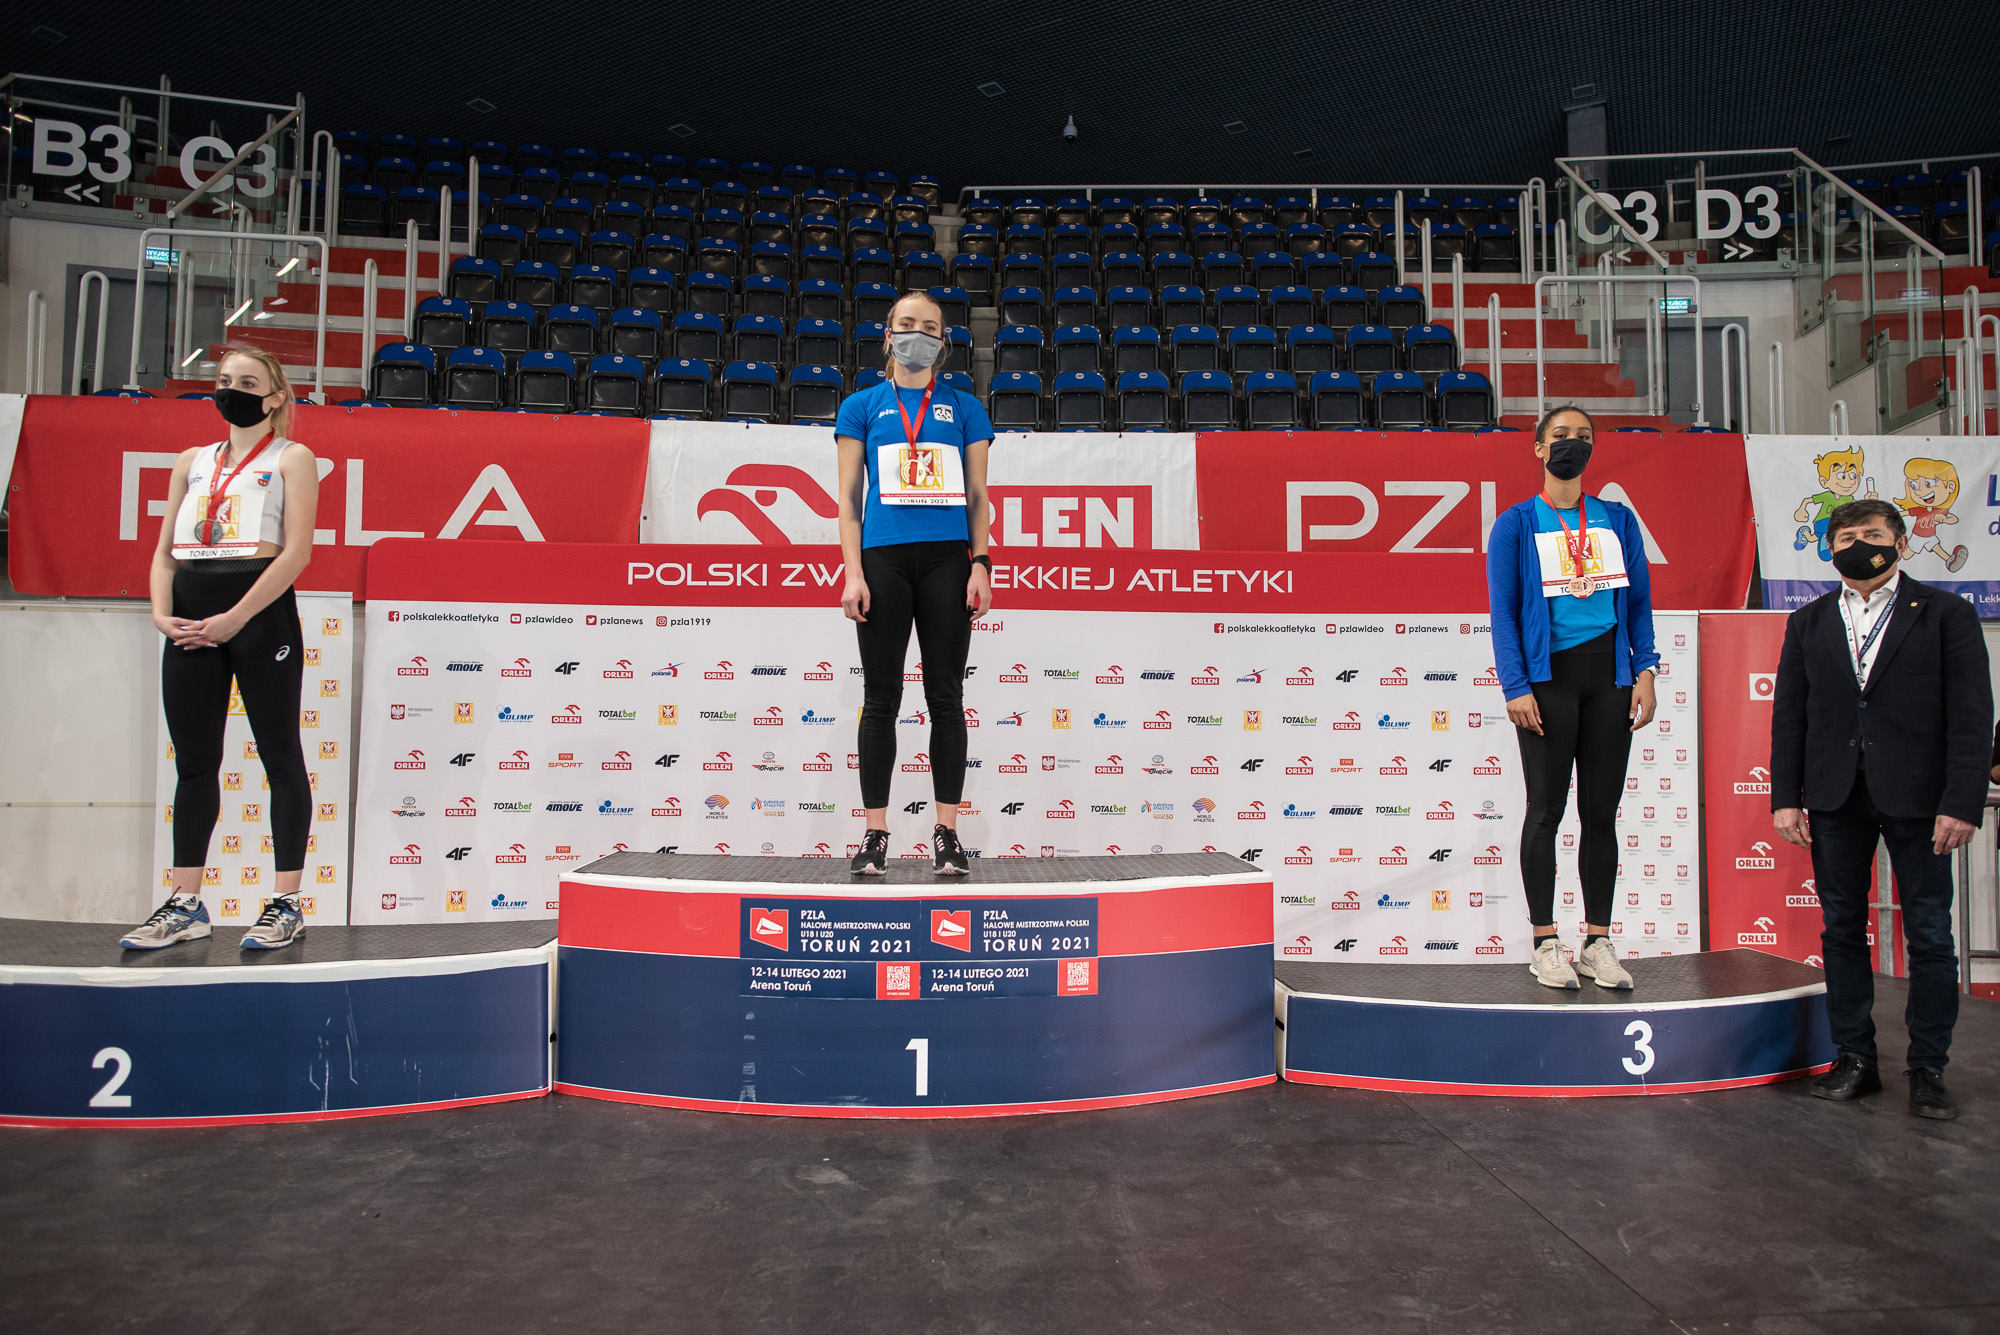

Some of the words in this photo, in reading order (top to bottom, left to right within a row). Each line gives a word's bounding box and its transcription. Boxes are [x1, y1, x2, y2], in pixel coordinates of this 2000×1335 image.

[33, 118, 132, 183] B3
[179, 136, 278, 198] C3
[1575, 190, 1660, 245] C3
[1696, 185, 1781, 240] D3
[1920, 516, 1936, 529] OLA
[628, 562, 768, 587] POLSKI
[990, 565, 1115, 591] EKKIEJ
[1126, 568, 1294, 595] ATLETYKI
[403, 613, 499, 622] polskalekkoatletyka
[525, 616, 573, 625] pzlawideo
[600, 617, 643, 626] pzlanews
[671, 618, 711, 627] pzla1919
[1228, 625, 1315, 634] polskalekkoatletyka
[1340, 625, 1384, 633] pzlawideo
[1409, 625, 1448, 634] pzlanews
[555, 662, 580, 675] 4F
[1336, 670, 1359, 682] 4F
[599, 710, 636, 718] TOTALbet
[700, 710, 737, 718] TOTALbet
[1188, 715, 1223, 724] TOTALbet
[450, 754, 475, 766] 4F
[655, 754, 680, 767] 4F
[1240, 759, 1264, 771] 4F
[1429, 760, 1452, 772] 4F
[494, 802, 532, 810] TOTALbet
[799, 802, 835, 810] TOTALbet
[904, 802, 927, 814] 4F
[1001, 802, 1024, 815] 4F
[1091, 804, 1126, 812] TOTALbet
[1376, 805, 1411, 813] TOTALbet
[446, 848, 472, 860] 4F
[1429, 849, 1452, 862] 4F
[1281, 895, 1316, 904] TOTALbet
[801, 910, 826, 920] PZLA
[983, 910, 1008, 920] PZLA
[801, 936, 861, 952] TORUŃ
[870, 940, 911, 953] 2021
[983, 936, 1042, 952] TORUŃ
[1051, 937, 1090, 950] 2021
[1334, 939, 1357, 951] 4F
[750, 967, 779, 977] 12-14
[781, 968, 821, 978] LUTEGO
[823, 968, 847, 979] 2021
[932, 969, 960, 979] 12-14
[963, 968, 1003, 978] LUTEGO
[1005, 968, 1029, 978] 2021
[750, 980, 781, 991] Arena
[782, 979, 812, 991] Toruń
[931, 982, 962, 992] Arena
[964, 980, 994, 992] Toruń
[1622, 1020, 1655, 1075] 3
[905, 1039, 930, 1096] 1
[90, 1046, 133, 1108] 2
